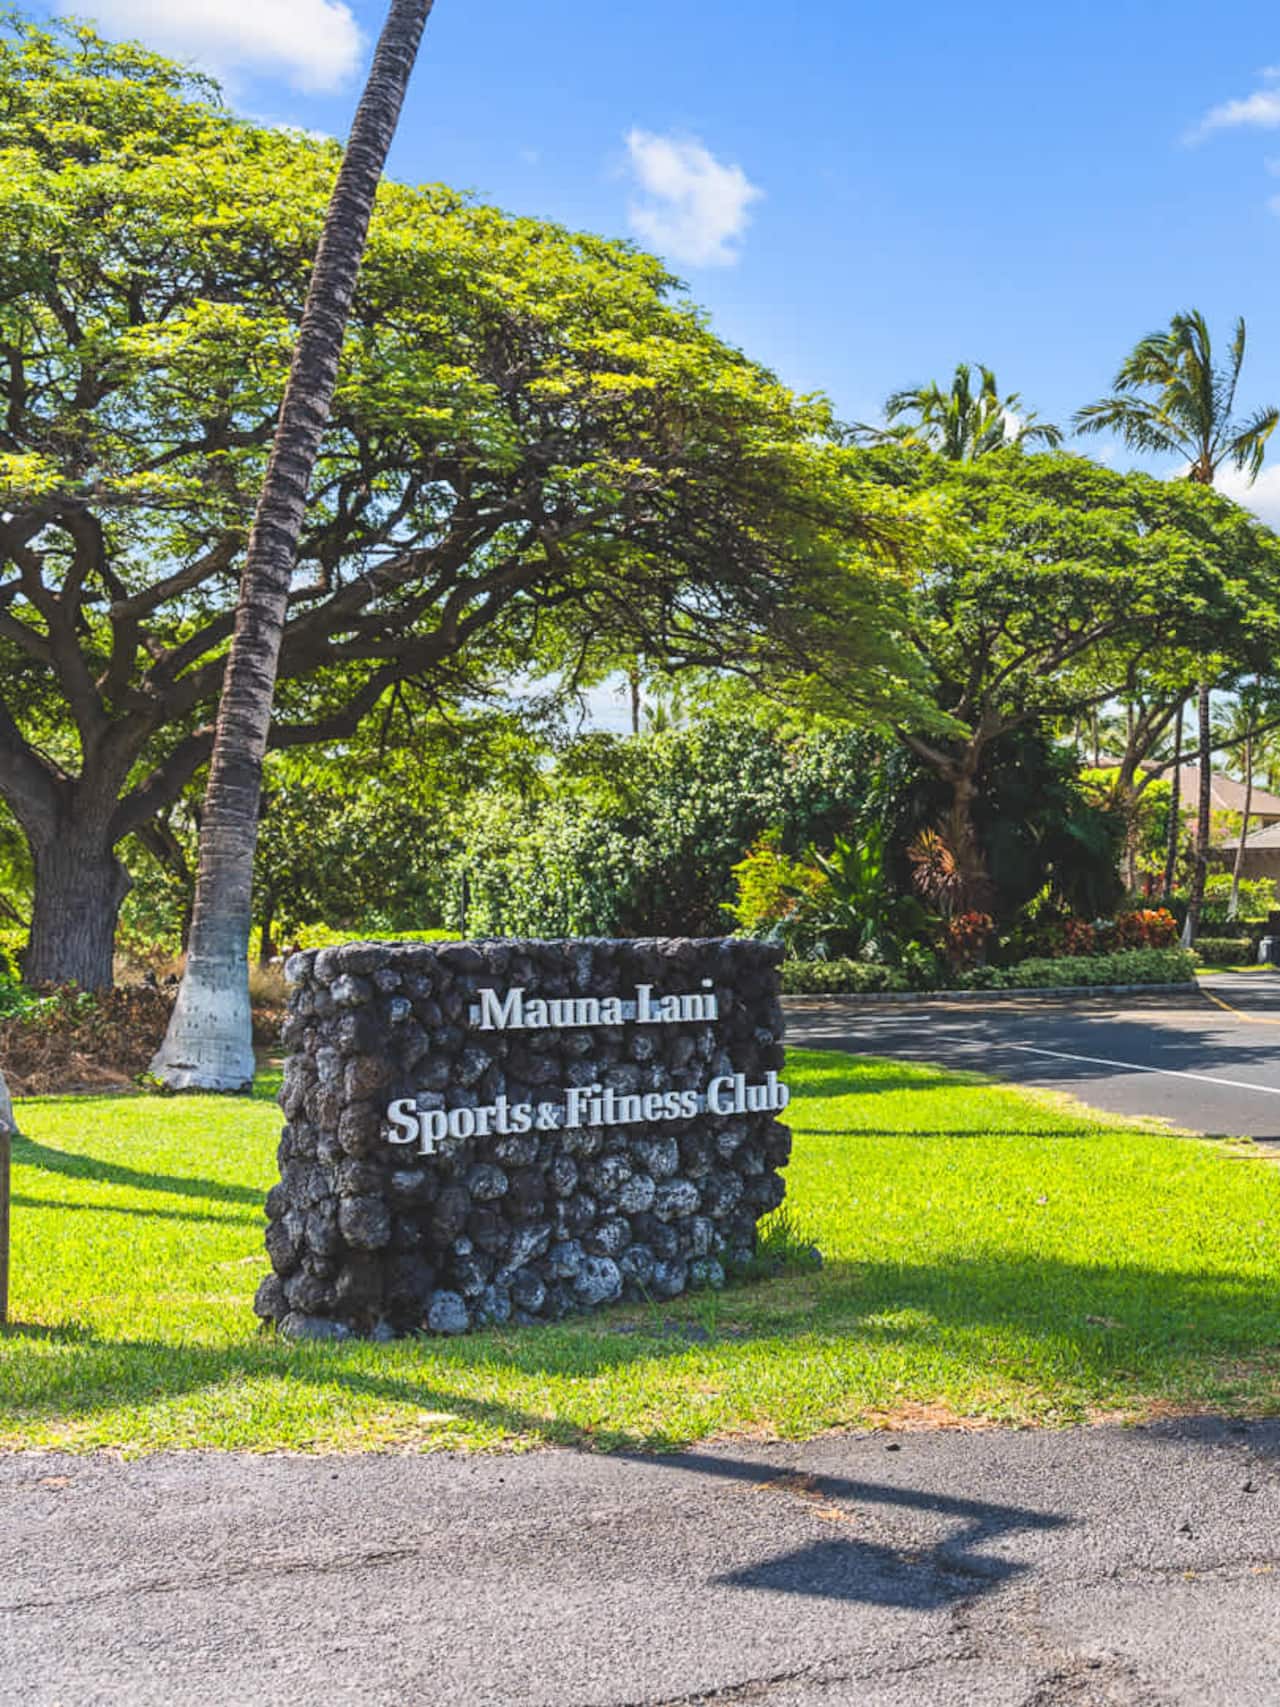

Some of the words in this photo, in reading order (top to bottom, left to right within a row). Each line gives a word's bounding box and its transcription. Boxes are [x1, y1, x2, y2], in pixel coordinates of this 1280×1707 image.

[477, 987, 625, 1030] Mauna
[635, 978, 718, 1024] Lani
[387, 1094, 533, 1155] Sports
[564, 1083, 698, 1129] Fitness
[707, 1070, 790, 1115] Club
